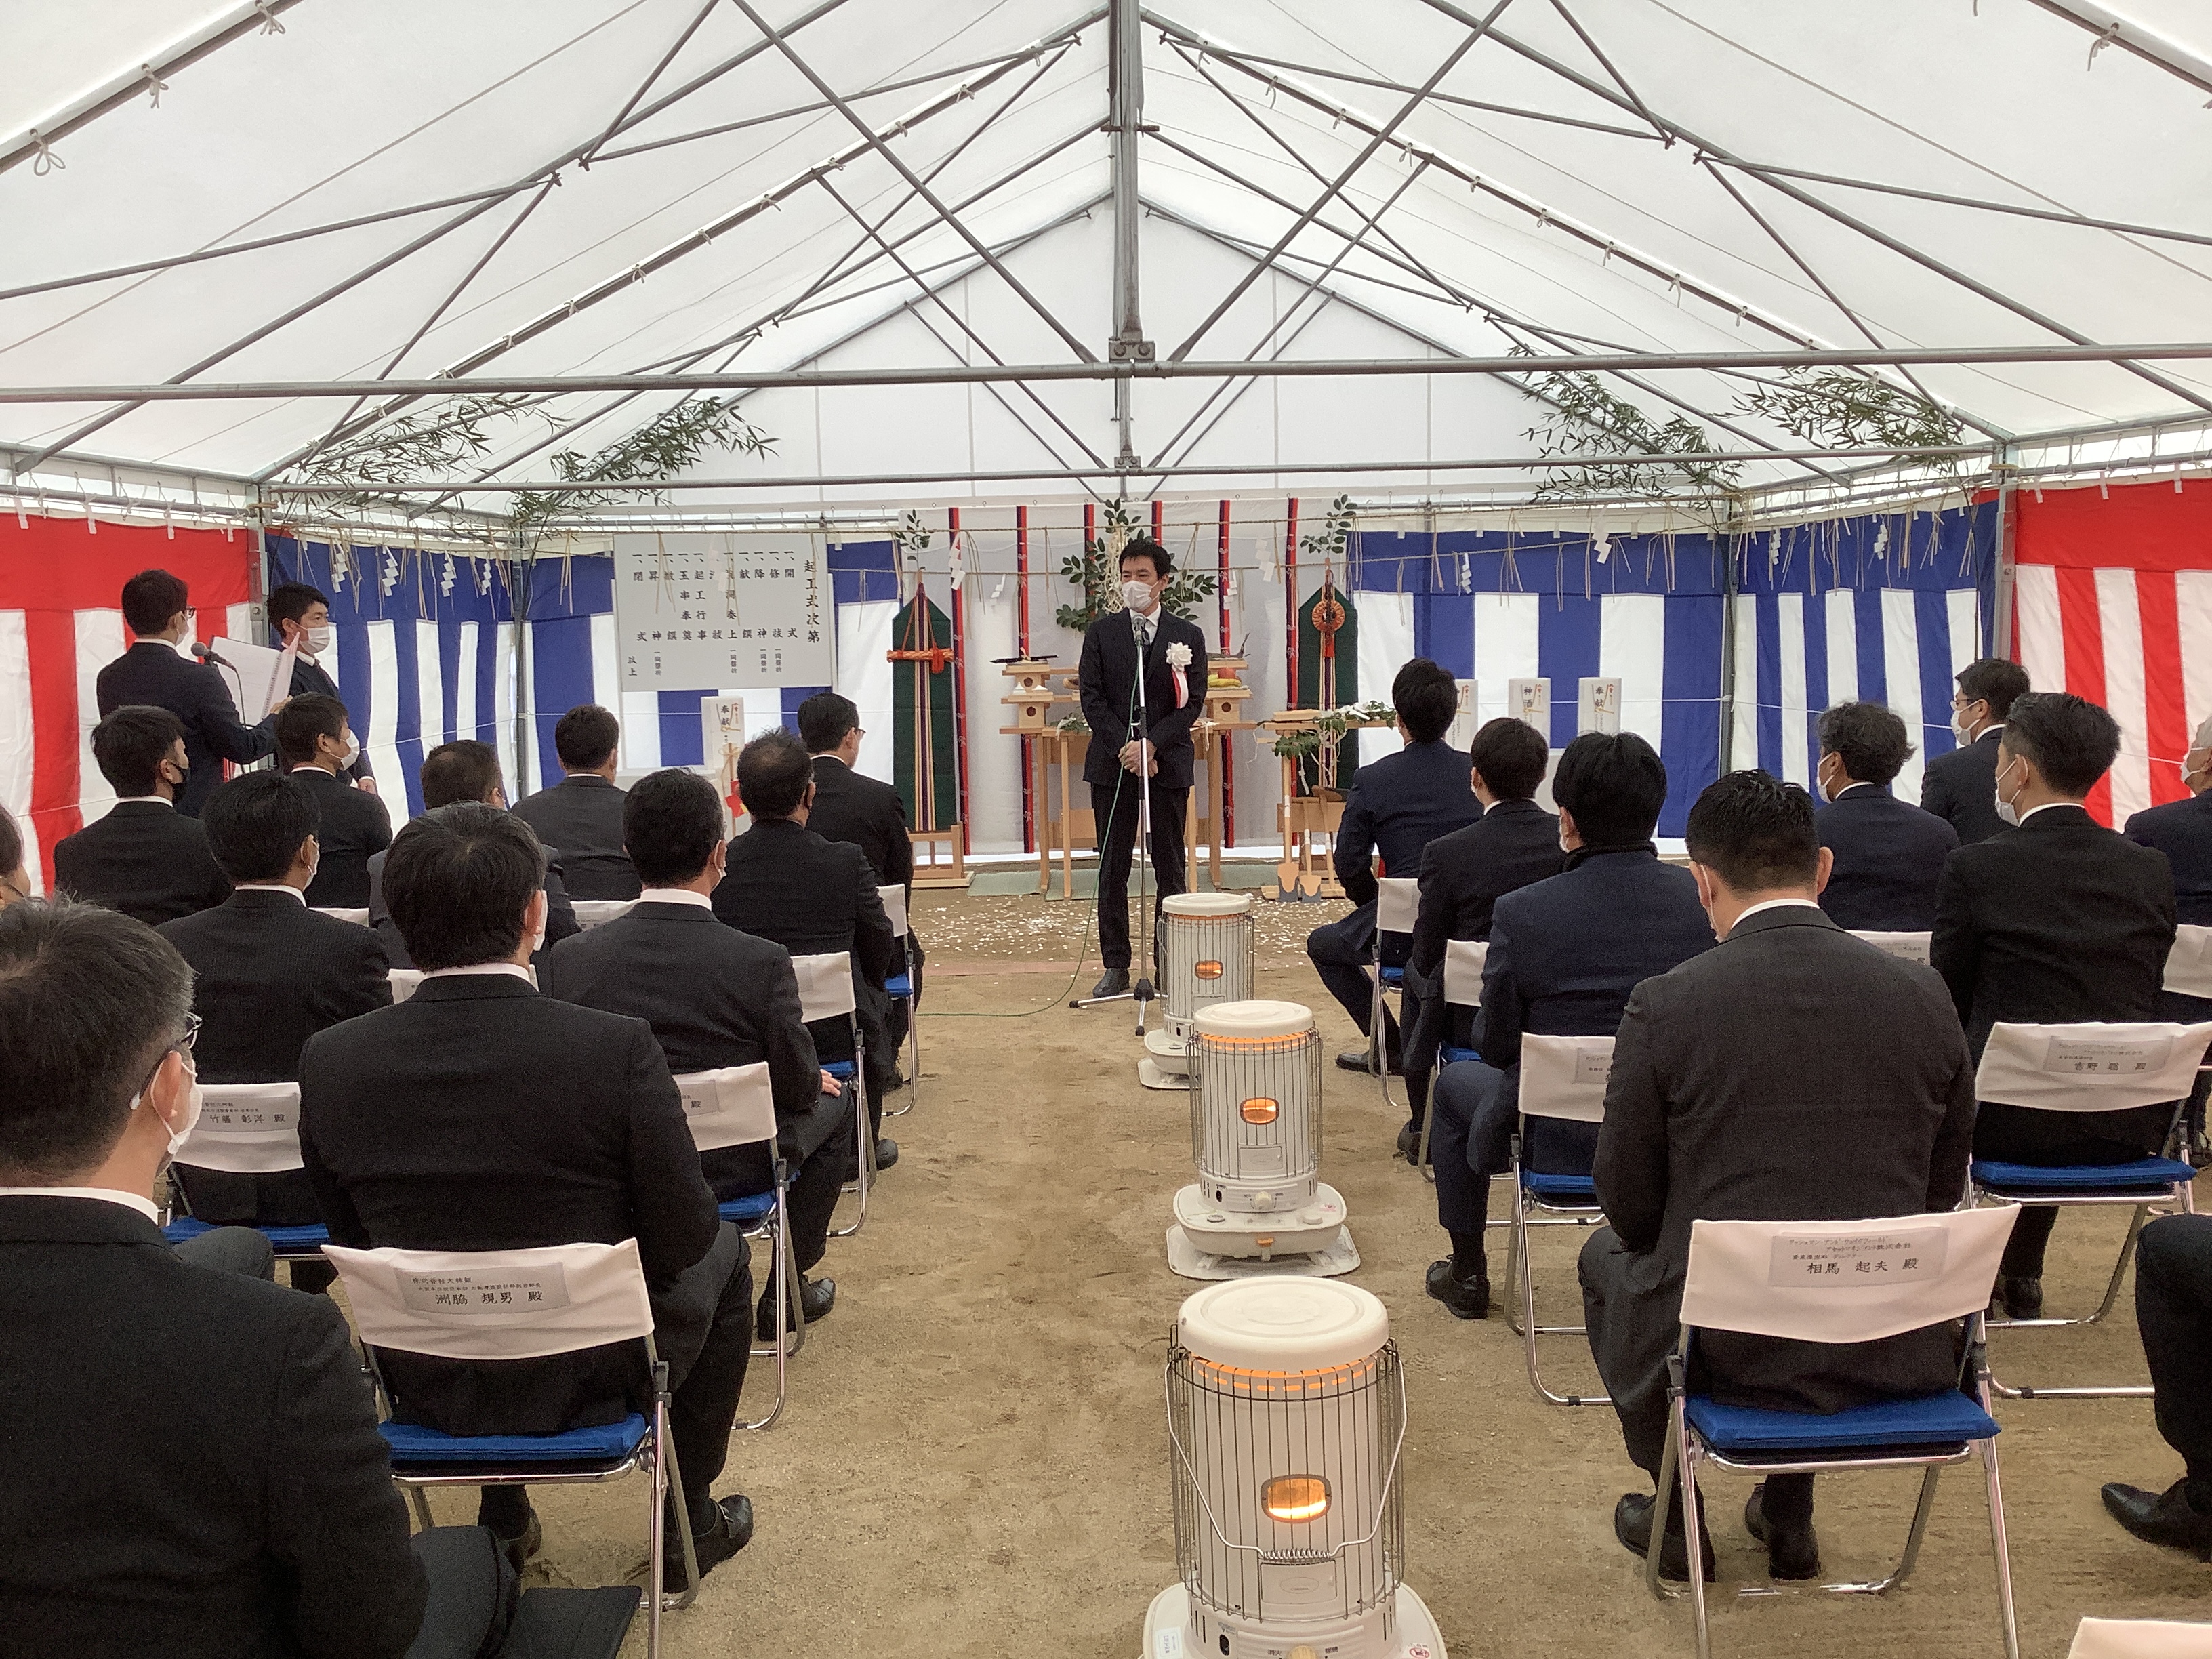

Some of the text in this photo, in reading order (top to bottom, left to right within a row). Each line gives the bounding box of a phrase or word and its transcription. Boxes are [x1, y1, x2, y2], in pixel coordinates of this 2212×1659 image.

[804, 560, 820, 644] 起工式次第
[628, 655, 638, 676] 以上
[1807, 1258, 1919, 1275] 相馬 起夫 殿
[482, 1292, 512, 1305] 規男
[528, 1290, 544, 1302] 殿
